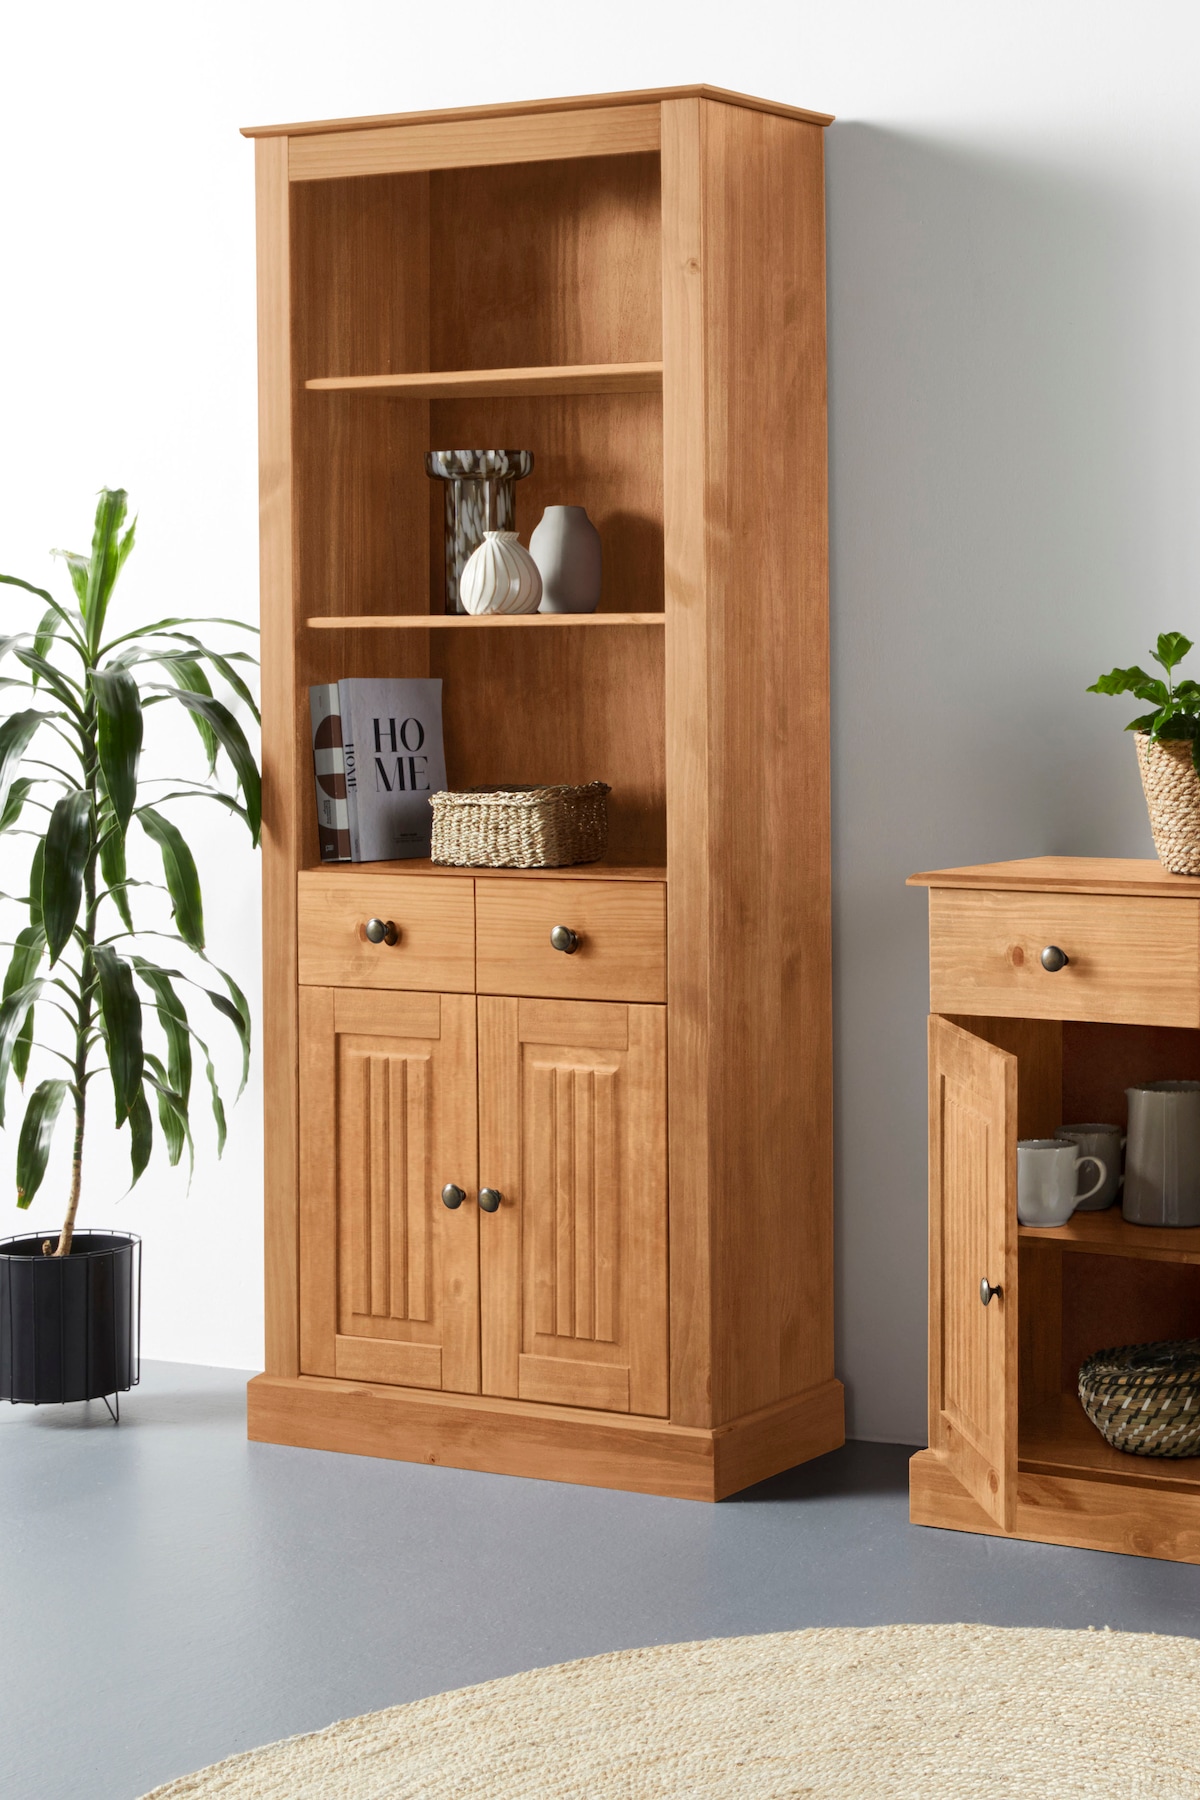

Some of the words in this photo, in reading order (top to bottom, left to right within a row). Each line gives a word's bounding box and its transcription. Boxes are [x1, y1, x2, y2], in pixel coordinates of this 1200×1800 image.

[373, 718, 425, 752] HO
[345, 743, 358, 794] HOME
[375, 756, 430, 792] ME
